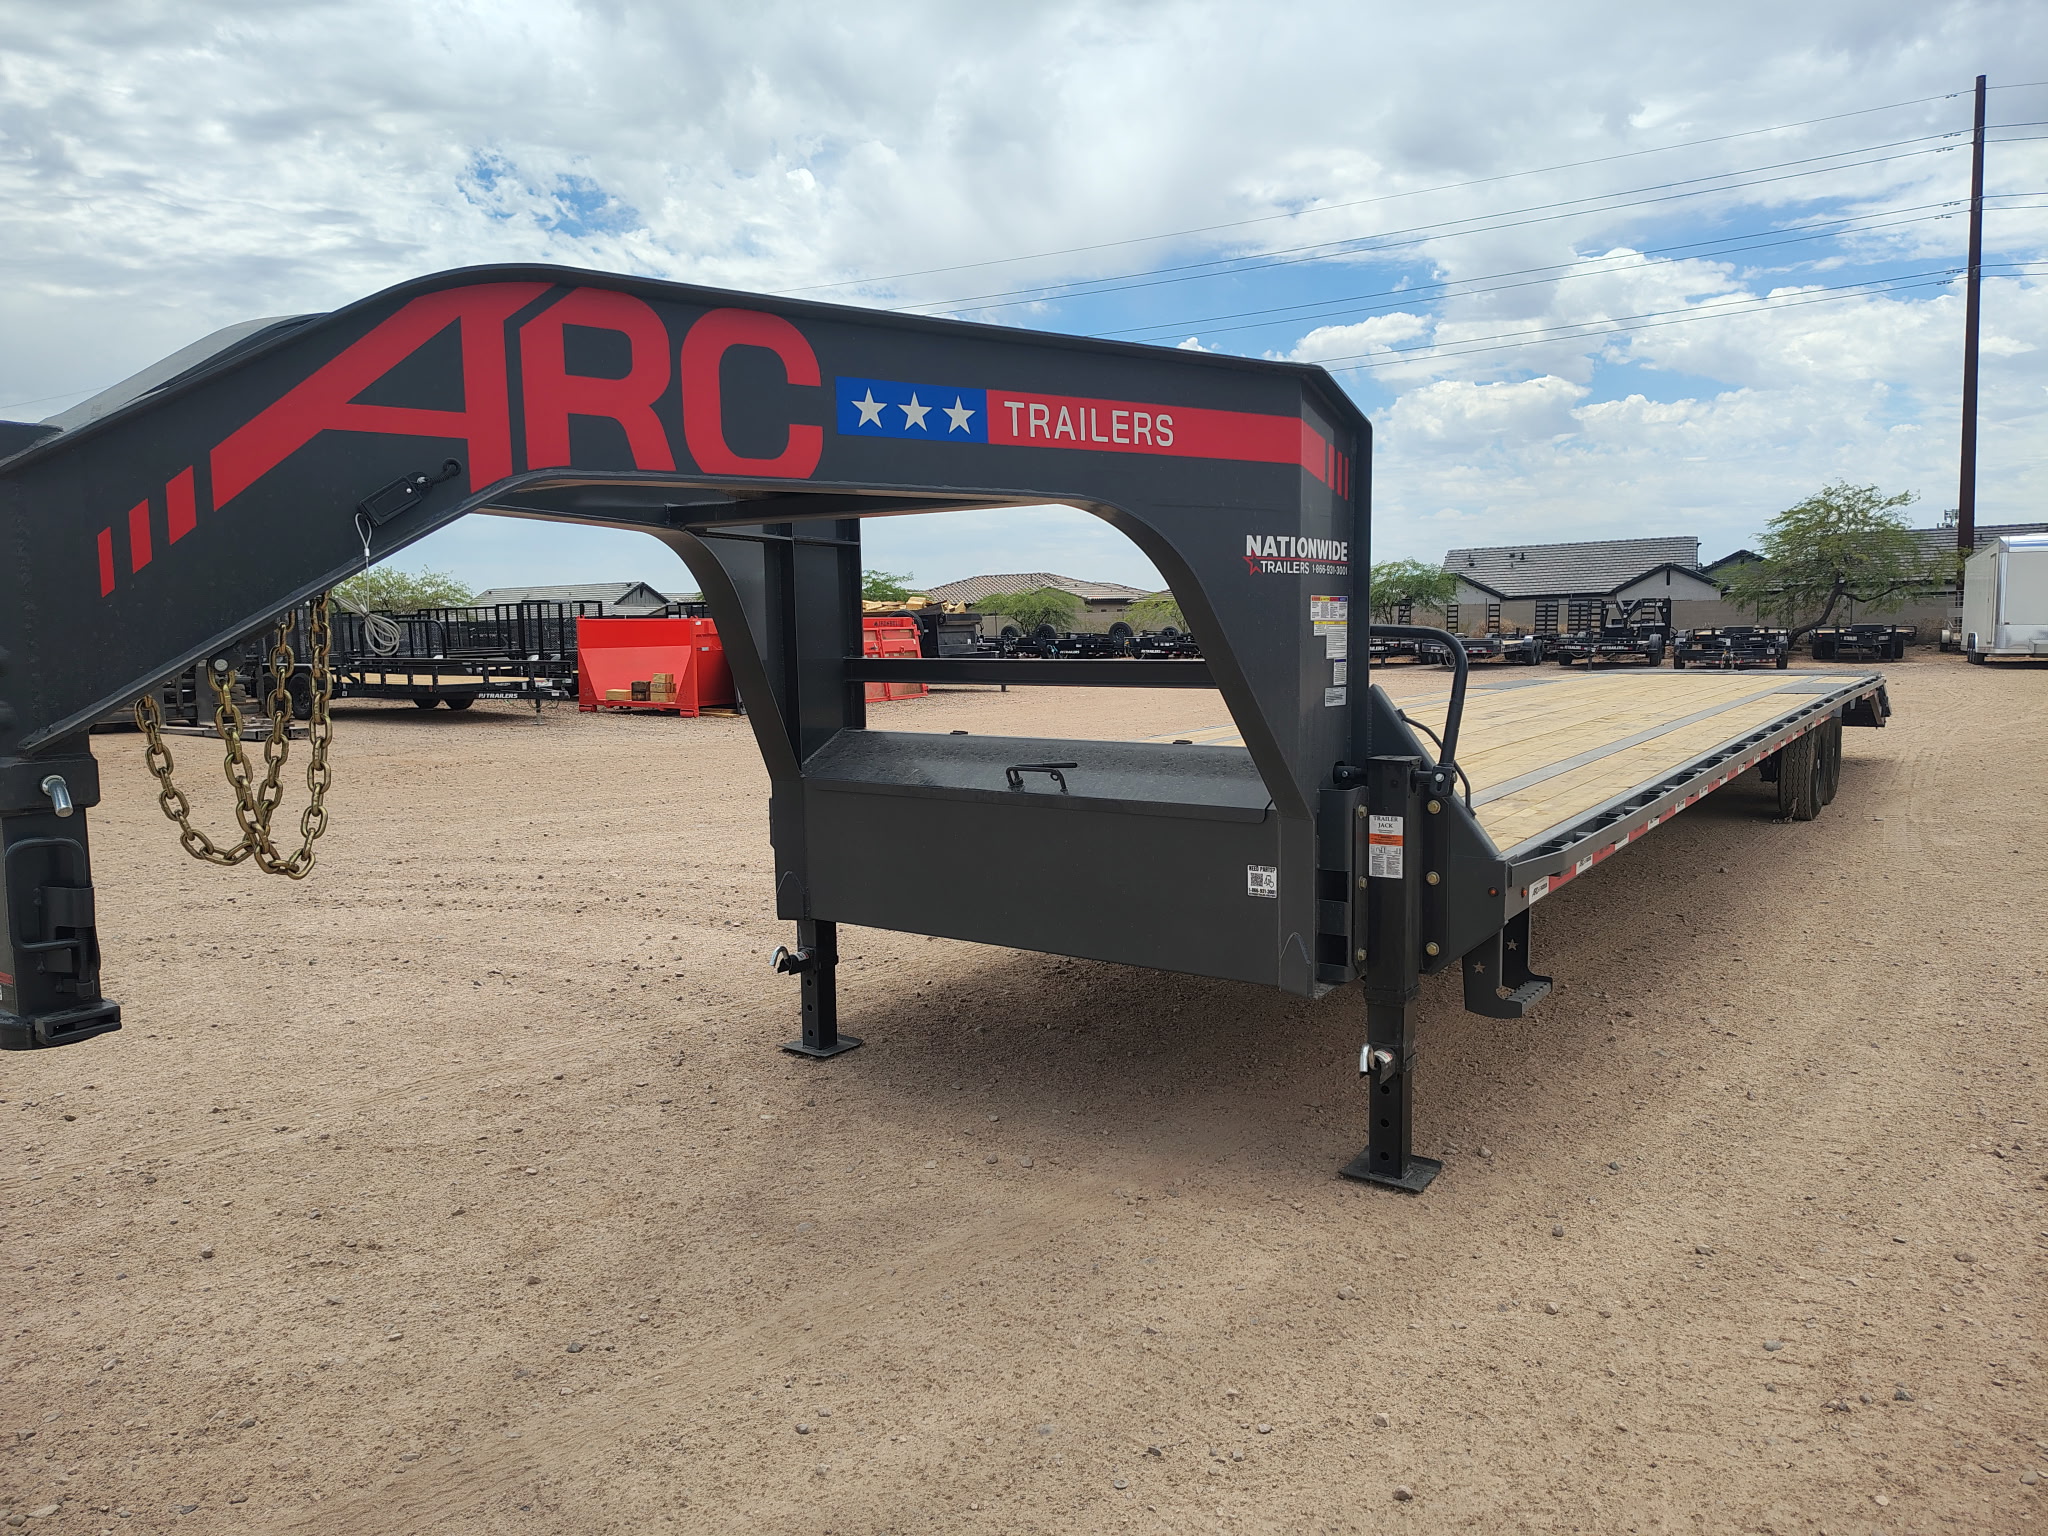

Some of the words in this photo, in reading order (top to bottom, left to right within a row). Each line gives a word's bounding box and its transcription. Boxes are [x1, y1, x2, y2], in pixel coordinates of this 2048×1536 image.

[209, 282, 824, 510] ARC
[1004, 401, 1174, 447] TRAILERS
[1246, 534, 1348, 562] NATIONWIDE
[1260, 561, 1310, 574] TRAILERS
[1312, 565, 1348, 576] 1-866-931-3001
